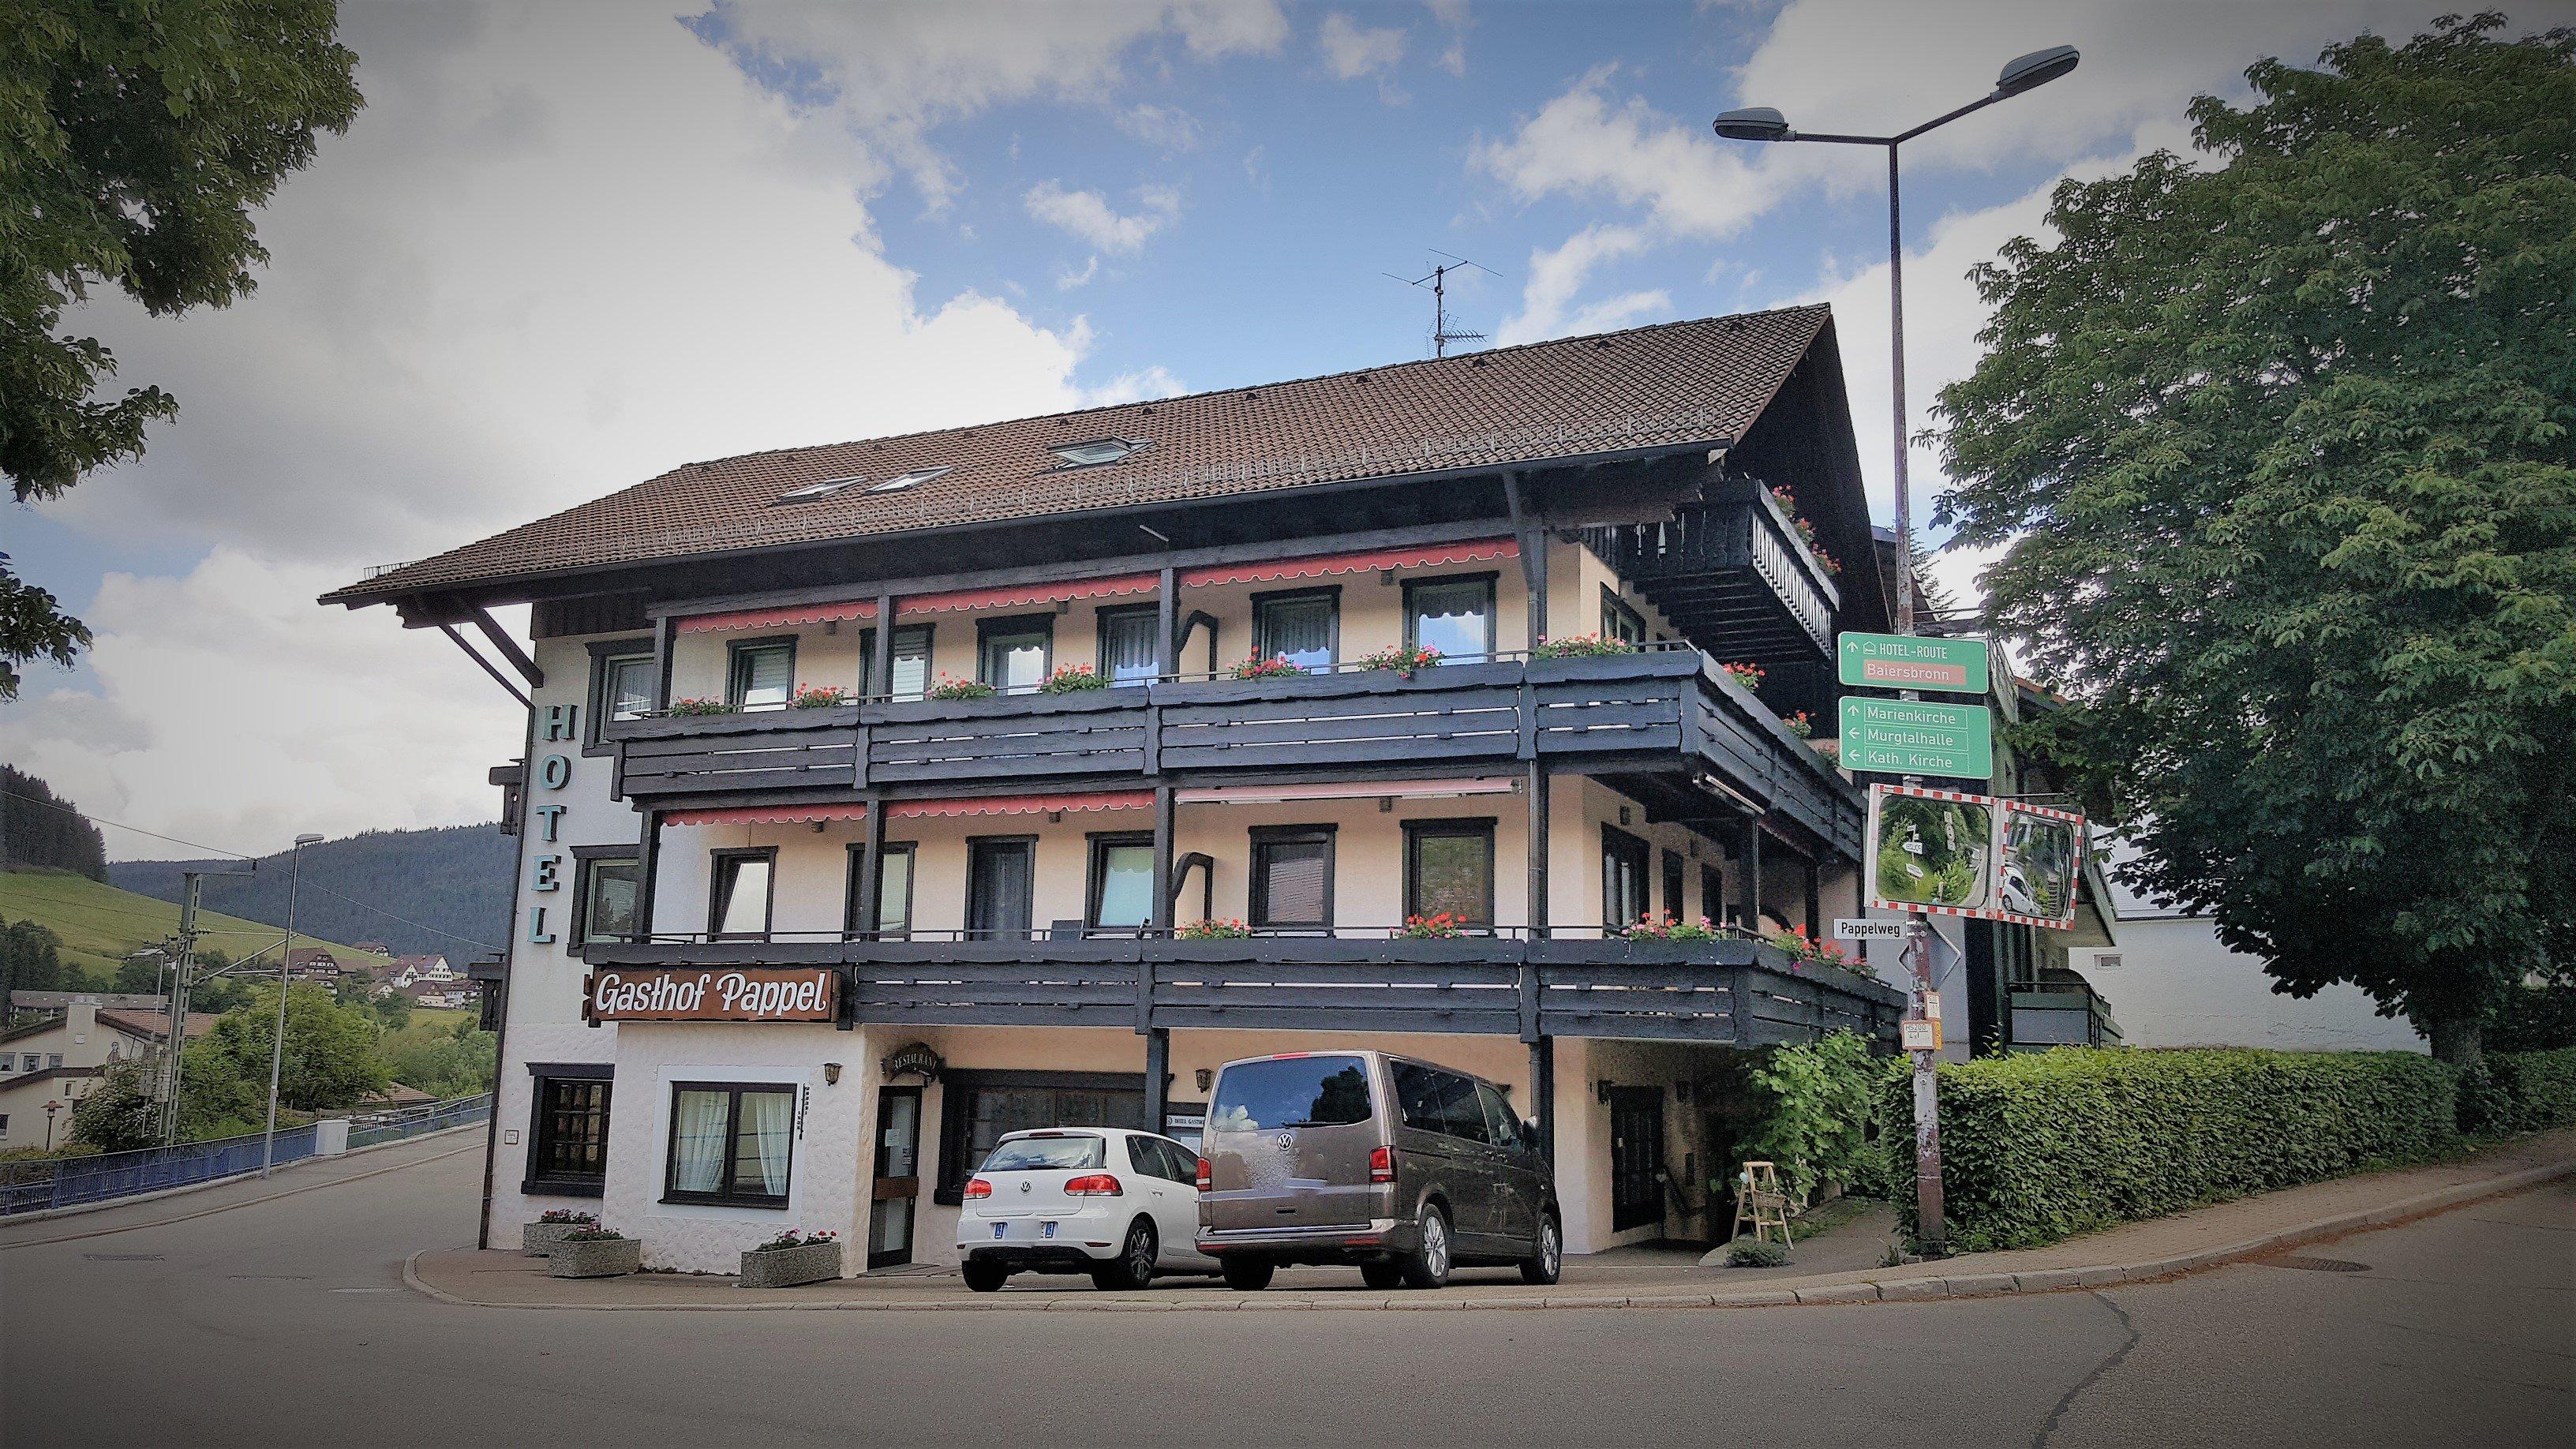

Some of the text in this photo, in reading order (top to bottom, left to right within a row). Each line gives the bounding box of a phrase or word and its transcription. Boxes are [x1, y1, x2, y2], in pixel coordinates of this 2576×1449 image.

[1879, 642, 1948, 660] HOTEL-ROUTE
[1866, 663, 1950, 680] Baiersbronn
[1867, 706, 1956, 724] Marienkirche
[1867, 728, 1953, 746] Murgtalhalle
[1868, 751, 1953, 768] Kath. Kirche
[527, 704, 578, 944] HOTEL
[1841, 922, 1900, 938] Pappelweg
[595, 972, 827, 1017] Gasthof Pappel
